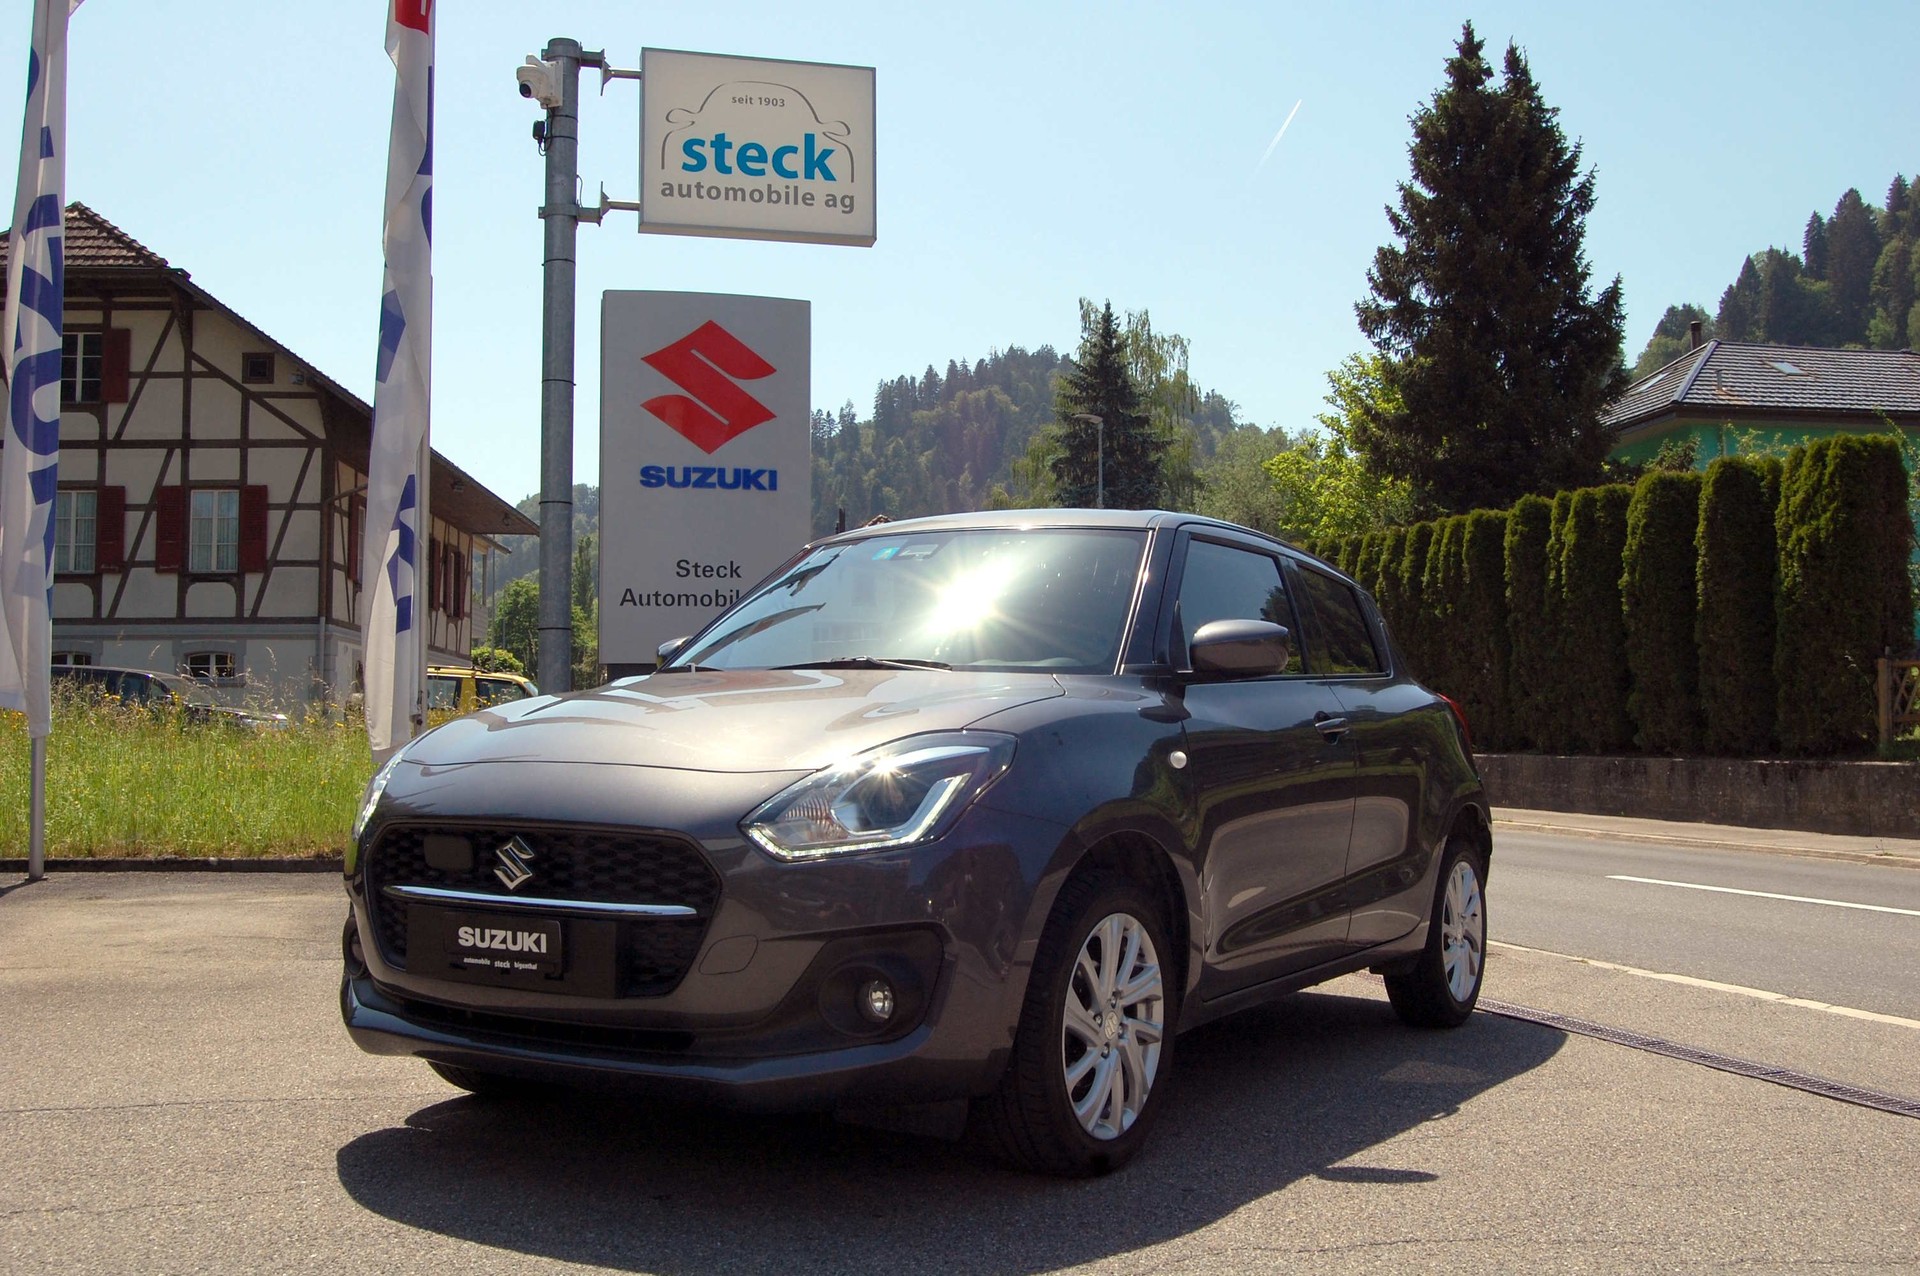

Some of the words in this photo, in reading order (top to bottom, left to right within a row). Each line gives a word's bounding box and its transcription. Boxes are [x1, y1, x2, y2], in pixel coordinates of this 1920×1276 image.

[731, 94, 754, 105] seit
[757, 96, 786, 107] 1903
[681, 132, 837, 182] steck
[660, 181, 816, 206] automobile
[824, 194, 855, 214] ag
[639, 465, 778, 491] SUZUKI
[675, 559, 742, 579] Steck
[458, 926, 547, 953] SUZUKI
